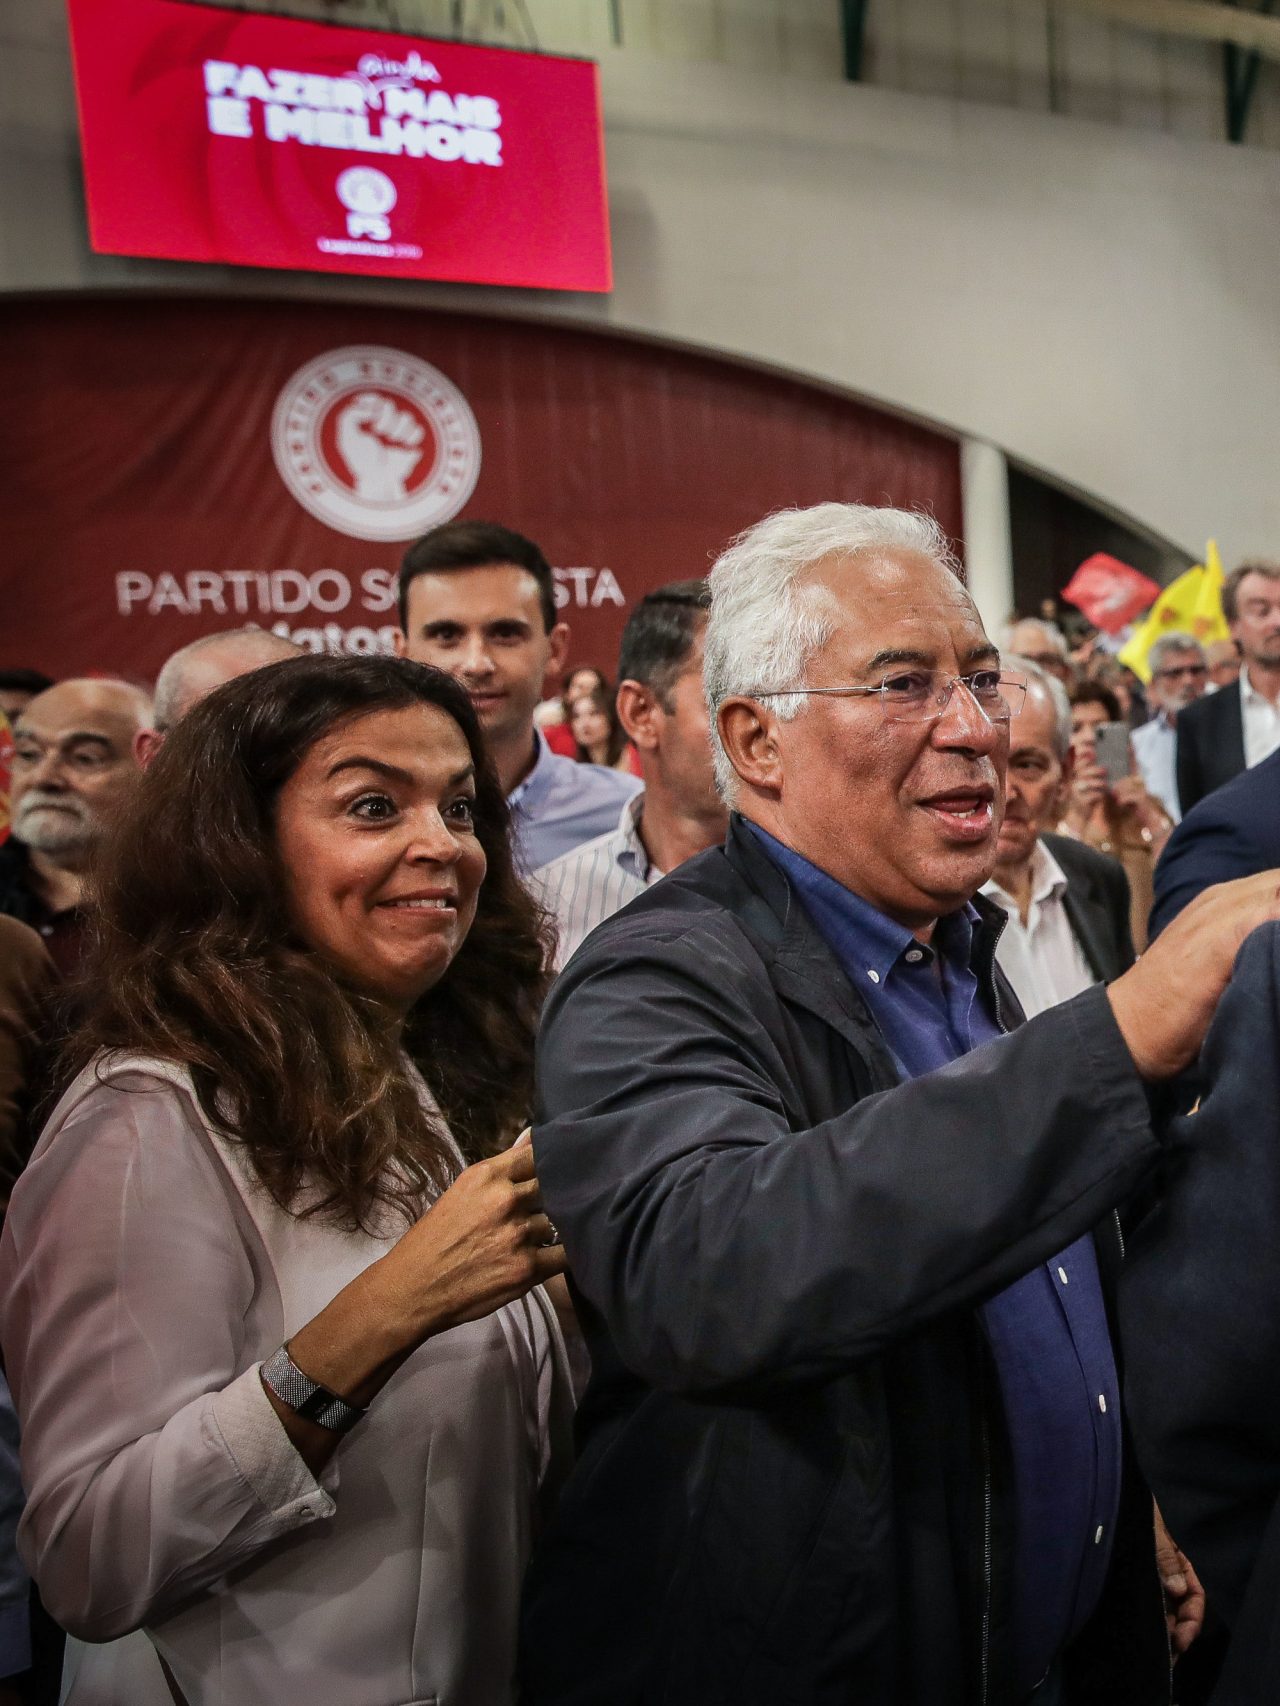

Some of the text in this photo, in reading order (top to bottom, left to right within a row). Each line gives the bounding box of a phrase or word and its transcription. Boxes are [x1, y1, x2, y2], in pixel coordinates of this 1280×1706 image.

[203, 58, 501, 131] FAZER MAIS
[205, 96, 503, 167] E MELHOR
[115, 568, 352, 615] PARTIDO
